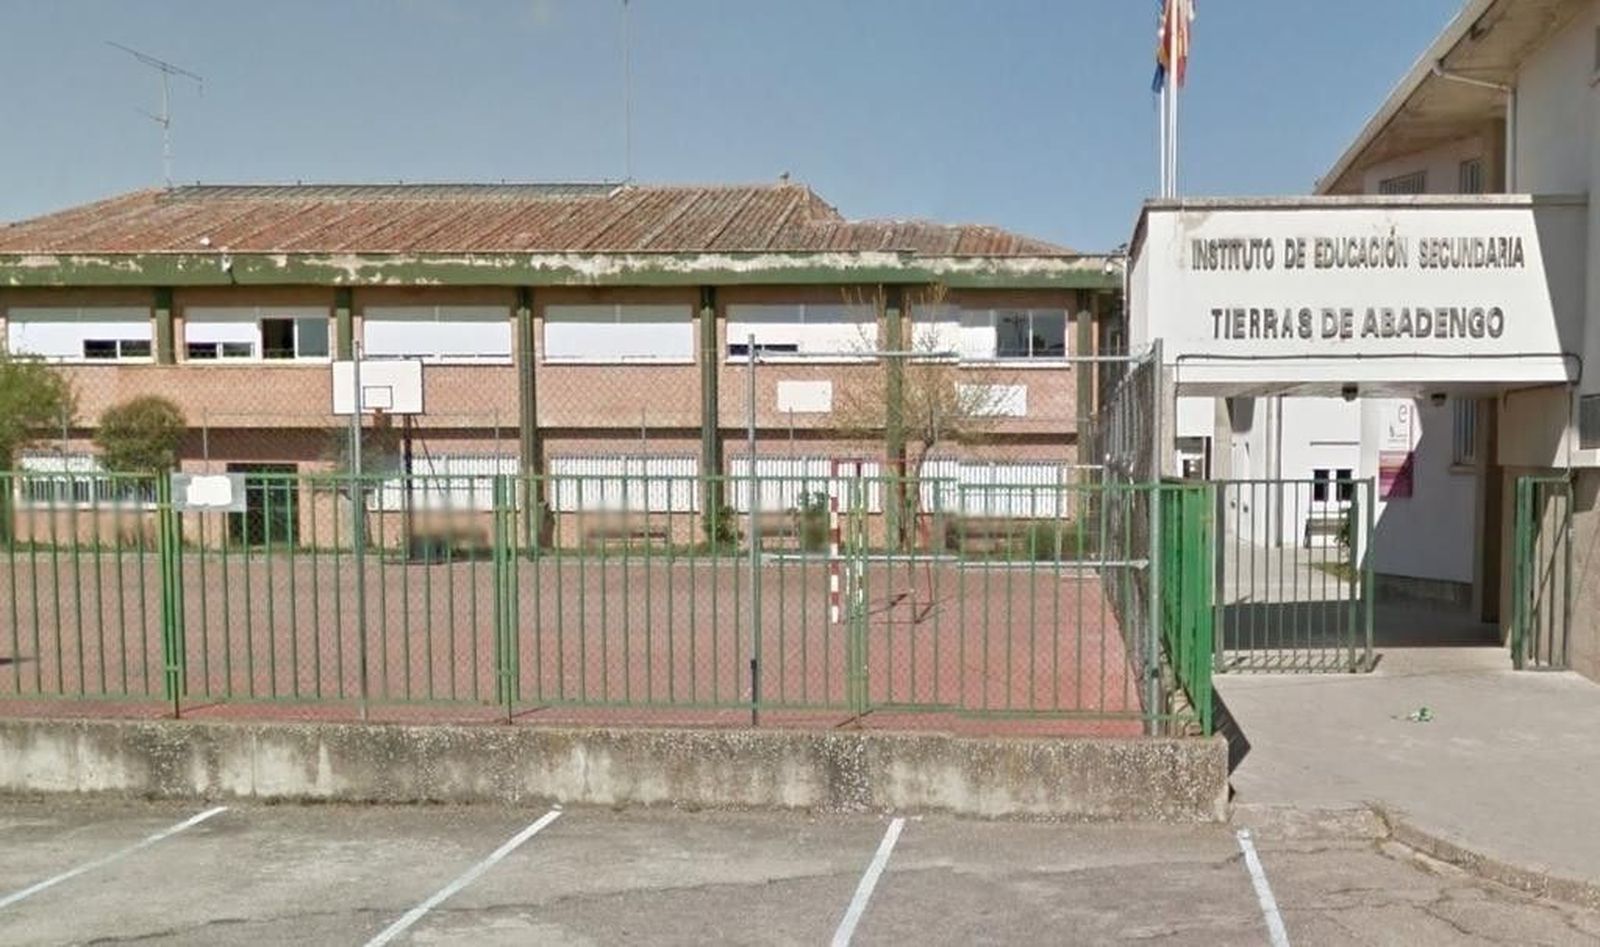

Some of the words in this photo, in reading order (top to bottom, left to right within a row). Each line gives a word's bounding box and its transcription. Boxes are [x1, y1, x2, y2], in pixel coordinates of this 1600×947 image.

[1192, 237, 1275, 270] INSTITUTO
[1284, 237, 1306, 269] DE
[1314, 227, 1409, 269] EDUCACIÓN
[1419, 236, 1525, 269] SECUNDARIA
[1211, 307, 1314, 340] TIERRAS
[1321, 307, 1354, 339] DE
[1360, 306, 1505, 339] ABADENGO
